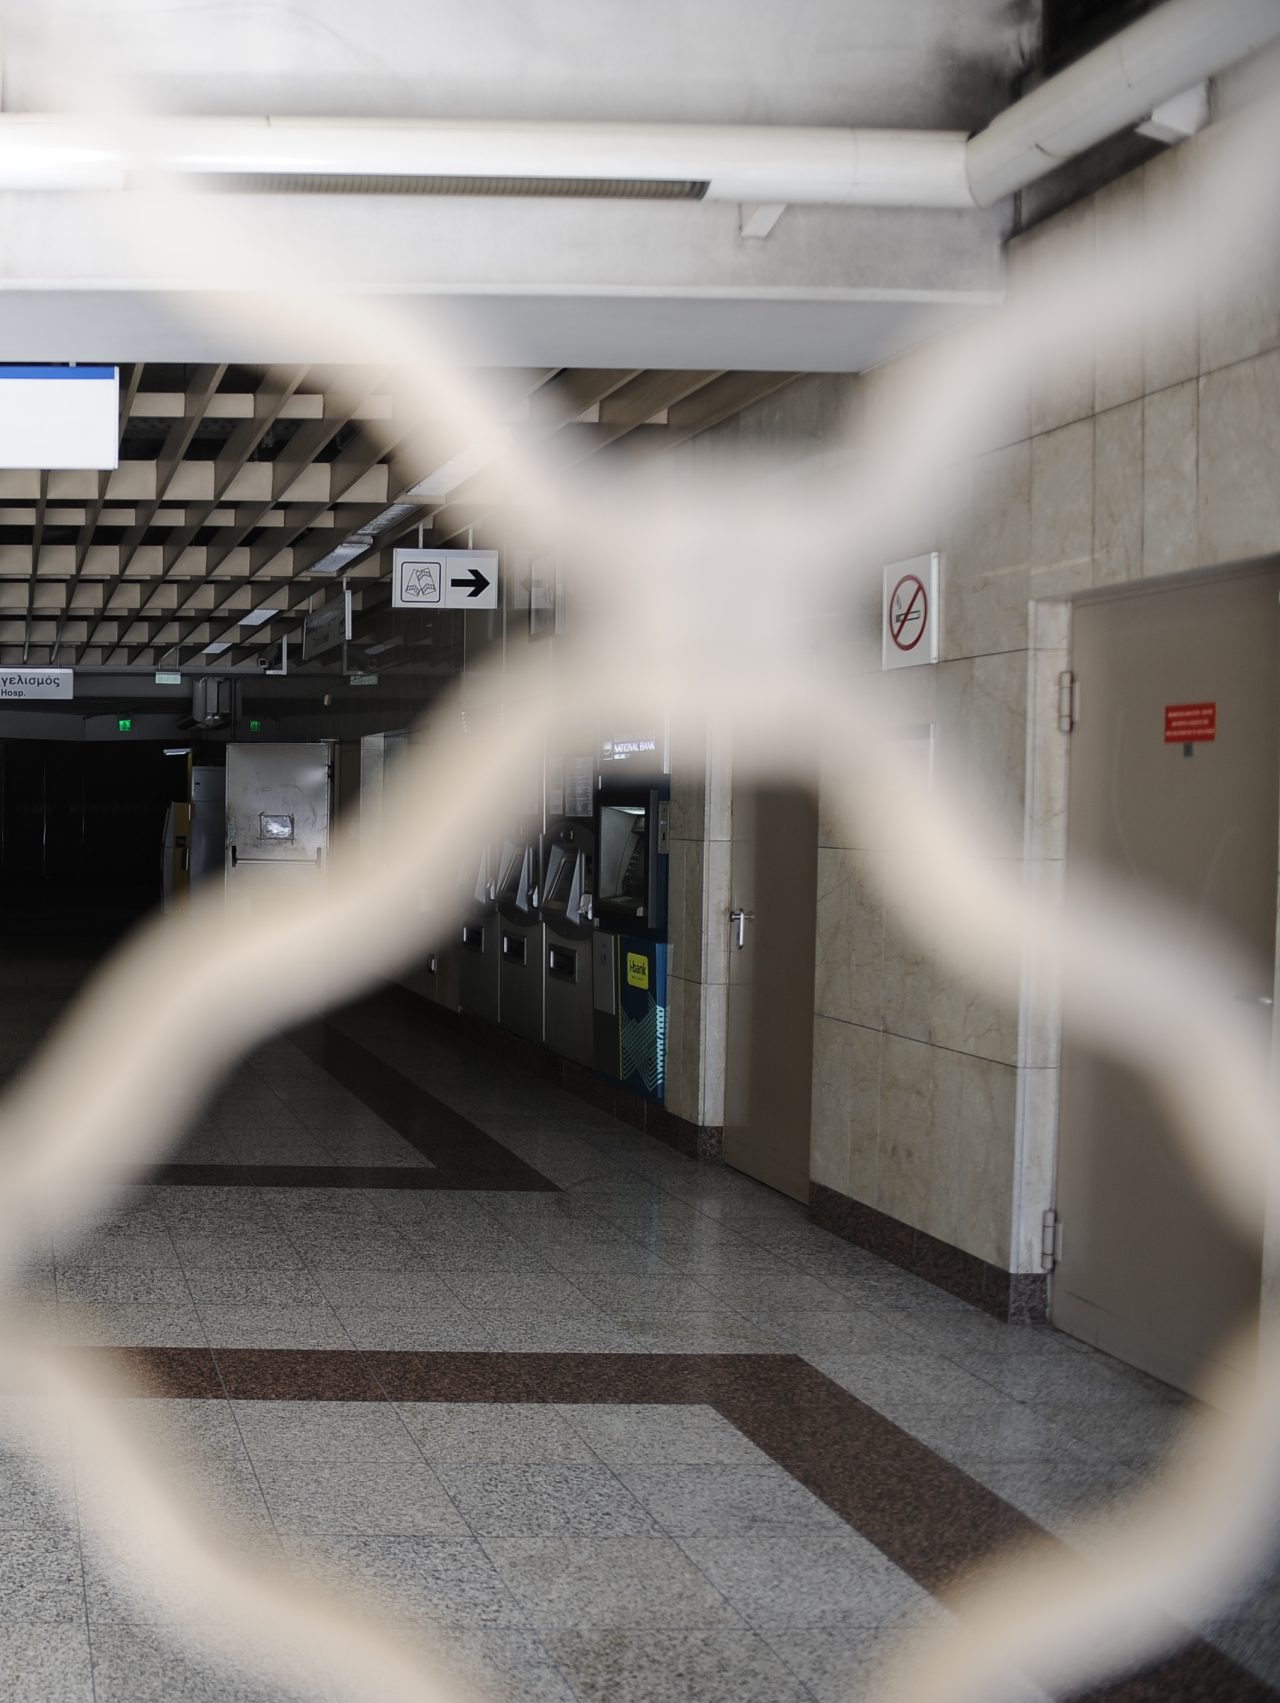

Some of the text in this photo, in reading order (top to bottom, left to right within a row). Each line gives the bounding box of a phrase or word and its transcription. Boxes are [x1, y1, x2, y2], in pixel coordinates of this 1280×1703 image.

[0, 689, 26, 699] Hosp.
[613, 740, 656, 753] NATIONAL BANK
[629, 959, 647, 977] i-bank
